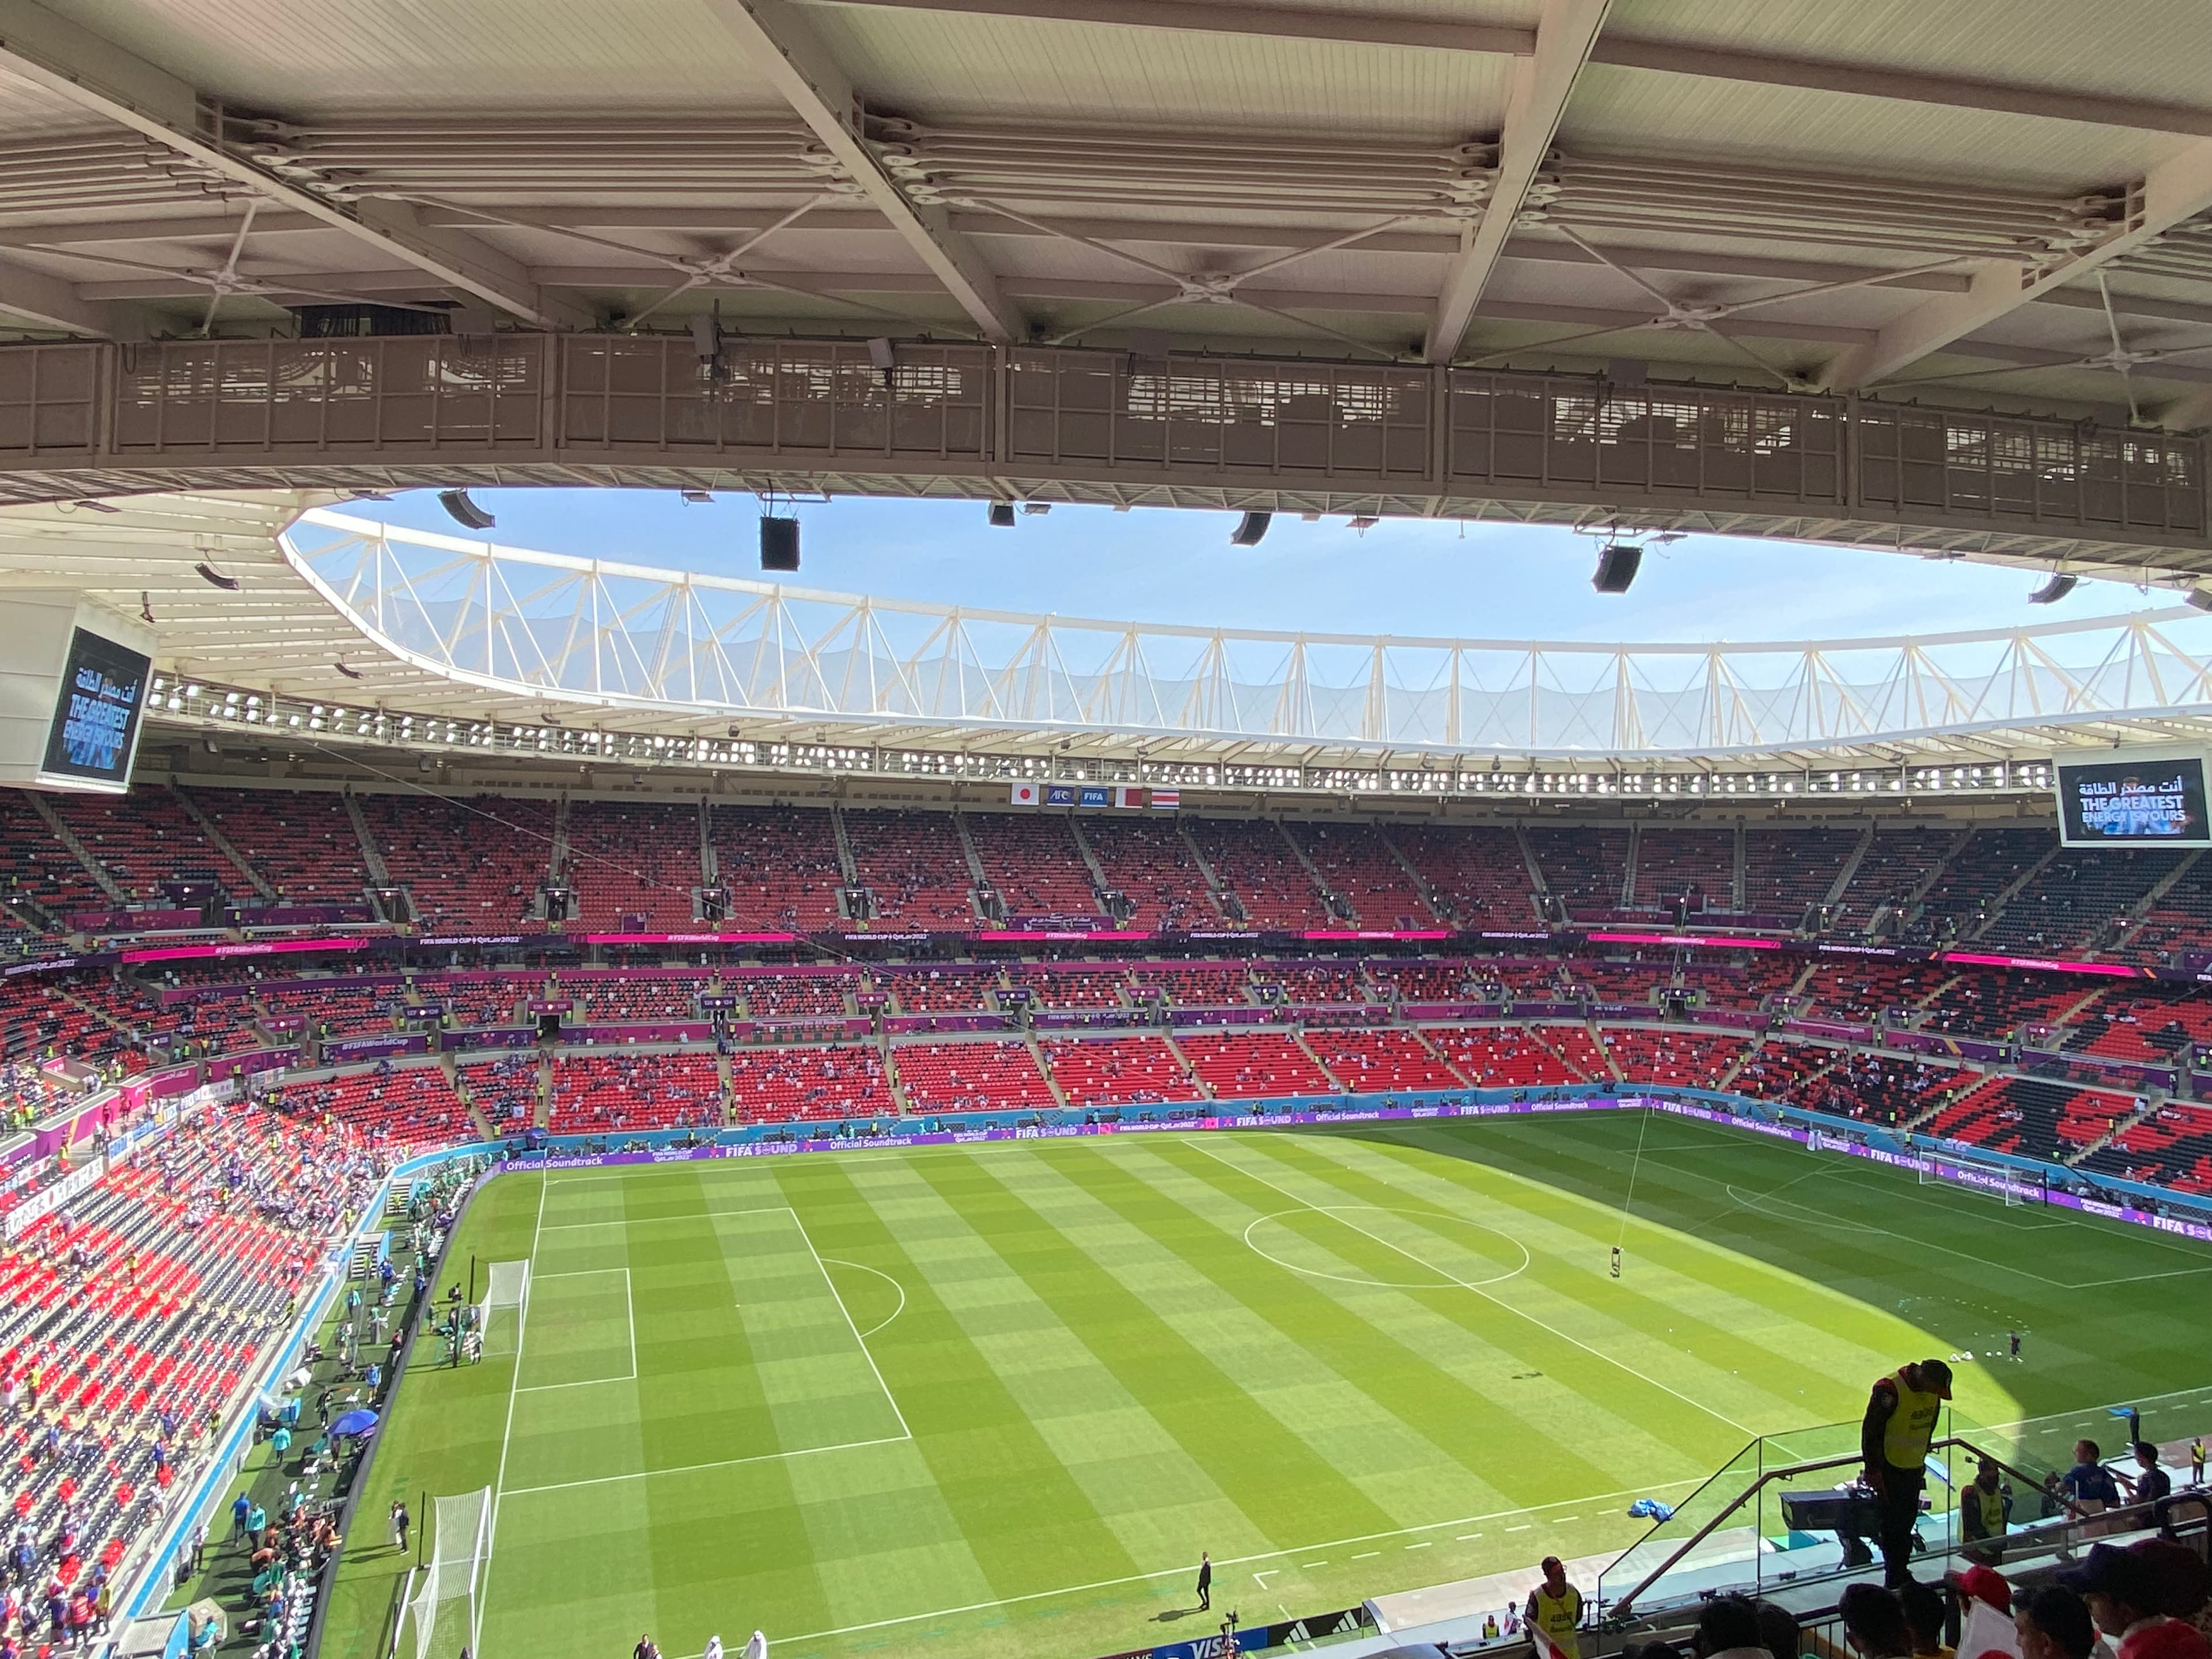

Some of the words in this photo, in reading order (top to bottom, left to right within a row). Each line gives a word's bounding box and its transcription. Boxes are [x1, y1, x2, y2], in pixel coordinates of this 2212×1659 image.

[70, 694, 90, 719] THE
[2079, 782, 2117, 796] الطاقة
[2158, 775, 2183, 793] أنت
[1050, 790, 1070, 800] AFC
[1084, 792, 1103, 801] FIFA
[2080, 797, 2107, 811] THE
[2108, 795, 2184, 810] GREATEST
[2082, 811, 2126, 823] ENERGY
[2143, 810, 2186, 821] YOURS
[342, 1038, 408, 1051] #FIFAWorldCup
[1460, 1105, 1479, 1115] FIFA
[1531, 1103, 1554, 1111] Official
[1554, 1101, 1589, 1110] Soundtrack
[1662, 1101, 1681, 1114] FIFA
[1236, 1116, 1257, 1127] FIFA
[1258, 1115, 1291, 1125] SOUND
[1316, 1112, 1340, 1122] Official
[1341, 1111, 1380, 1120] Soundtrack
[1016, 1128, 1039, 1139] FIFA
[1040, 1126, 1077, 1138] SOUND
[1732, 1116, 1755, 1129] Official
[1756, 1123, 1793, 1138] Soundtrack
[830, 1139, 862, 1150] Official
[863, 1136, 912, 1148] Soundtrack
[726, 1146, 753, 1158] FIFA
[755, 1143, 798, 1156] SOUND
[1870, 1149, 1892, 1163] FIFA
[507, 1158, 544, 1171] Official
[546, 1156, 603, 1169] Soundtrack
[2153, 1215, 2186, 1234] FIFA
